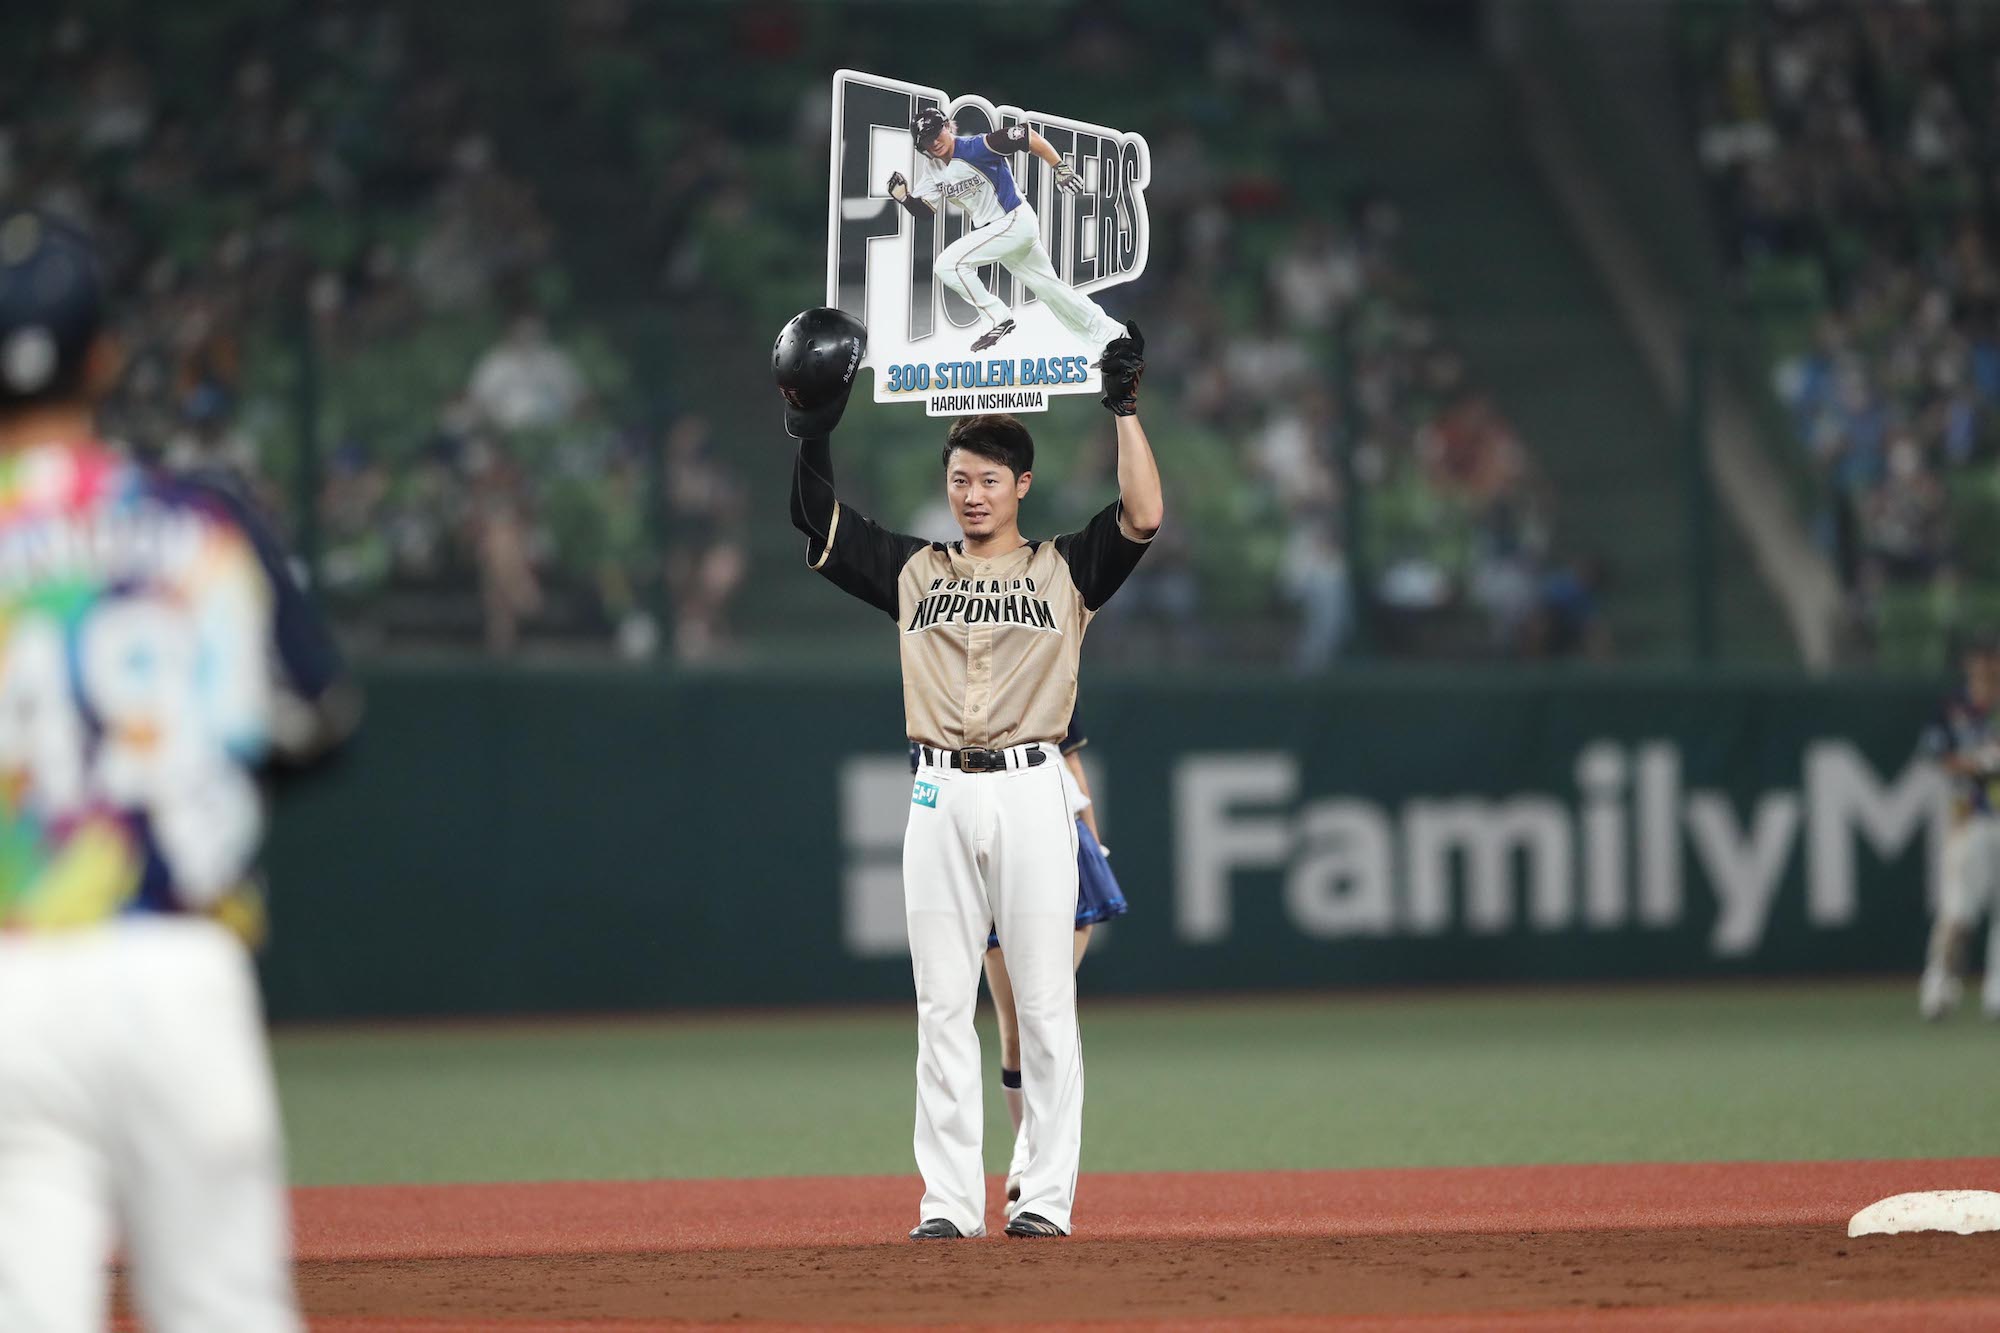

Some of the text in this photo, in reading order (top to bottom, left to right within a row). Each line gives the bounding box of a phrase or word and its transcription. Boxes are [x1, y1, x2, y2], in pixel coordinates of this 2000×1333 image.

[888, 356, 1088, 391] 300 STOLEN BASES
[931, 391, 1043, 412] HARUKI NISHIKAWA
[930, 576, 1036, 593] HOKKAIDO
[906, 593, 1061, 634] NIPPONHAM
[913, 784, 936, 803] ニトリ
